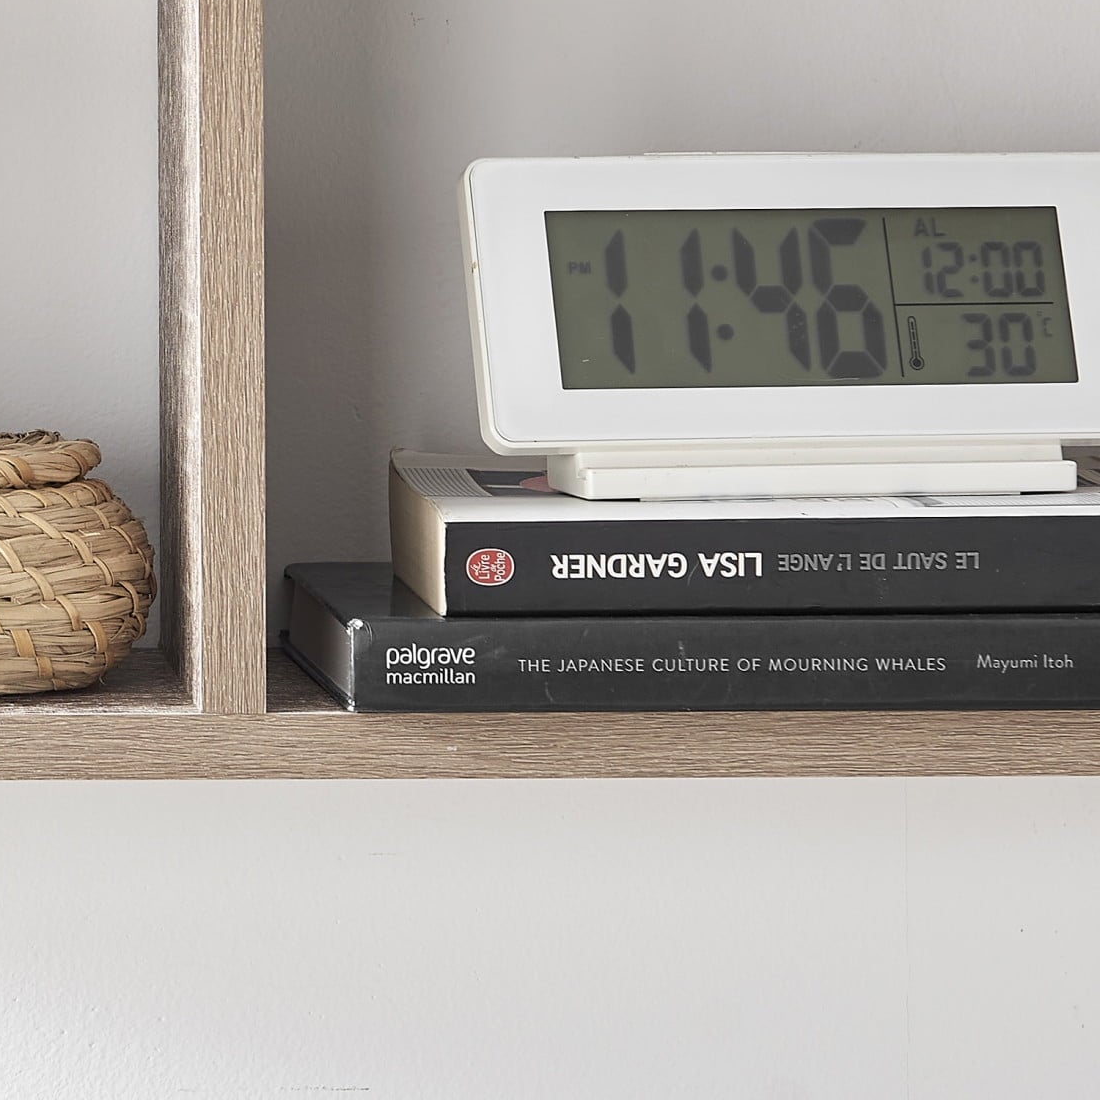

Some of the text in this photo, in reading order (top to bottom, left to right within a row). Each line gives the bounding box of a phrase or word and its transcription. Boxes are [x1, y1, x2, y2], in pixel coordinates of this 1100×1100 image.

[913, 216, 947, 238] AL
[922, 240, 1046, 298] 12:00
[604, 218, 888, 378] 11:46
[478, 554, 490, 580] Livre
[494, 552, 506, 581] Poche
[550, 552, 763, 579] LISA GARDNER
[859, 553, 886, 571] DE
[892, 552, 948, 570] SAUT
[954, 552, 980, 570] LE
[386, 642, 476, 669] palgrave
[517, 657, 946, 673] THE JAPANESE CULTURE OF MOURNING WHALES
[976, 653, 1074, 674] Mayumi Itoh
[386, 668, 476, 685] macmillan
